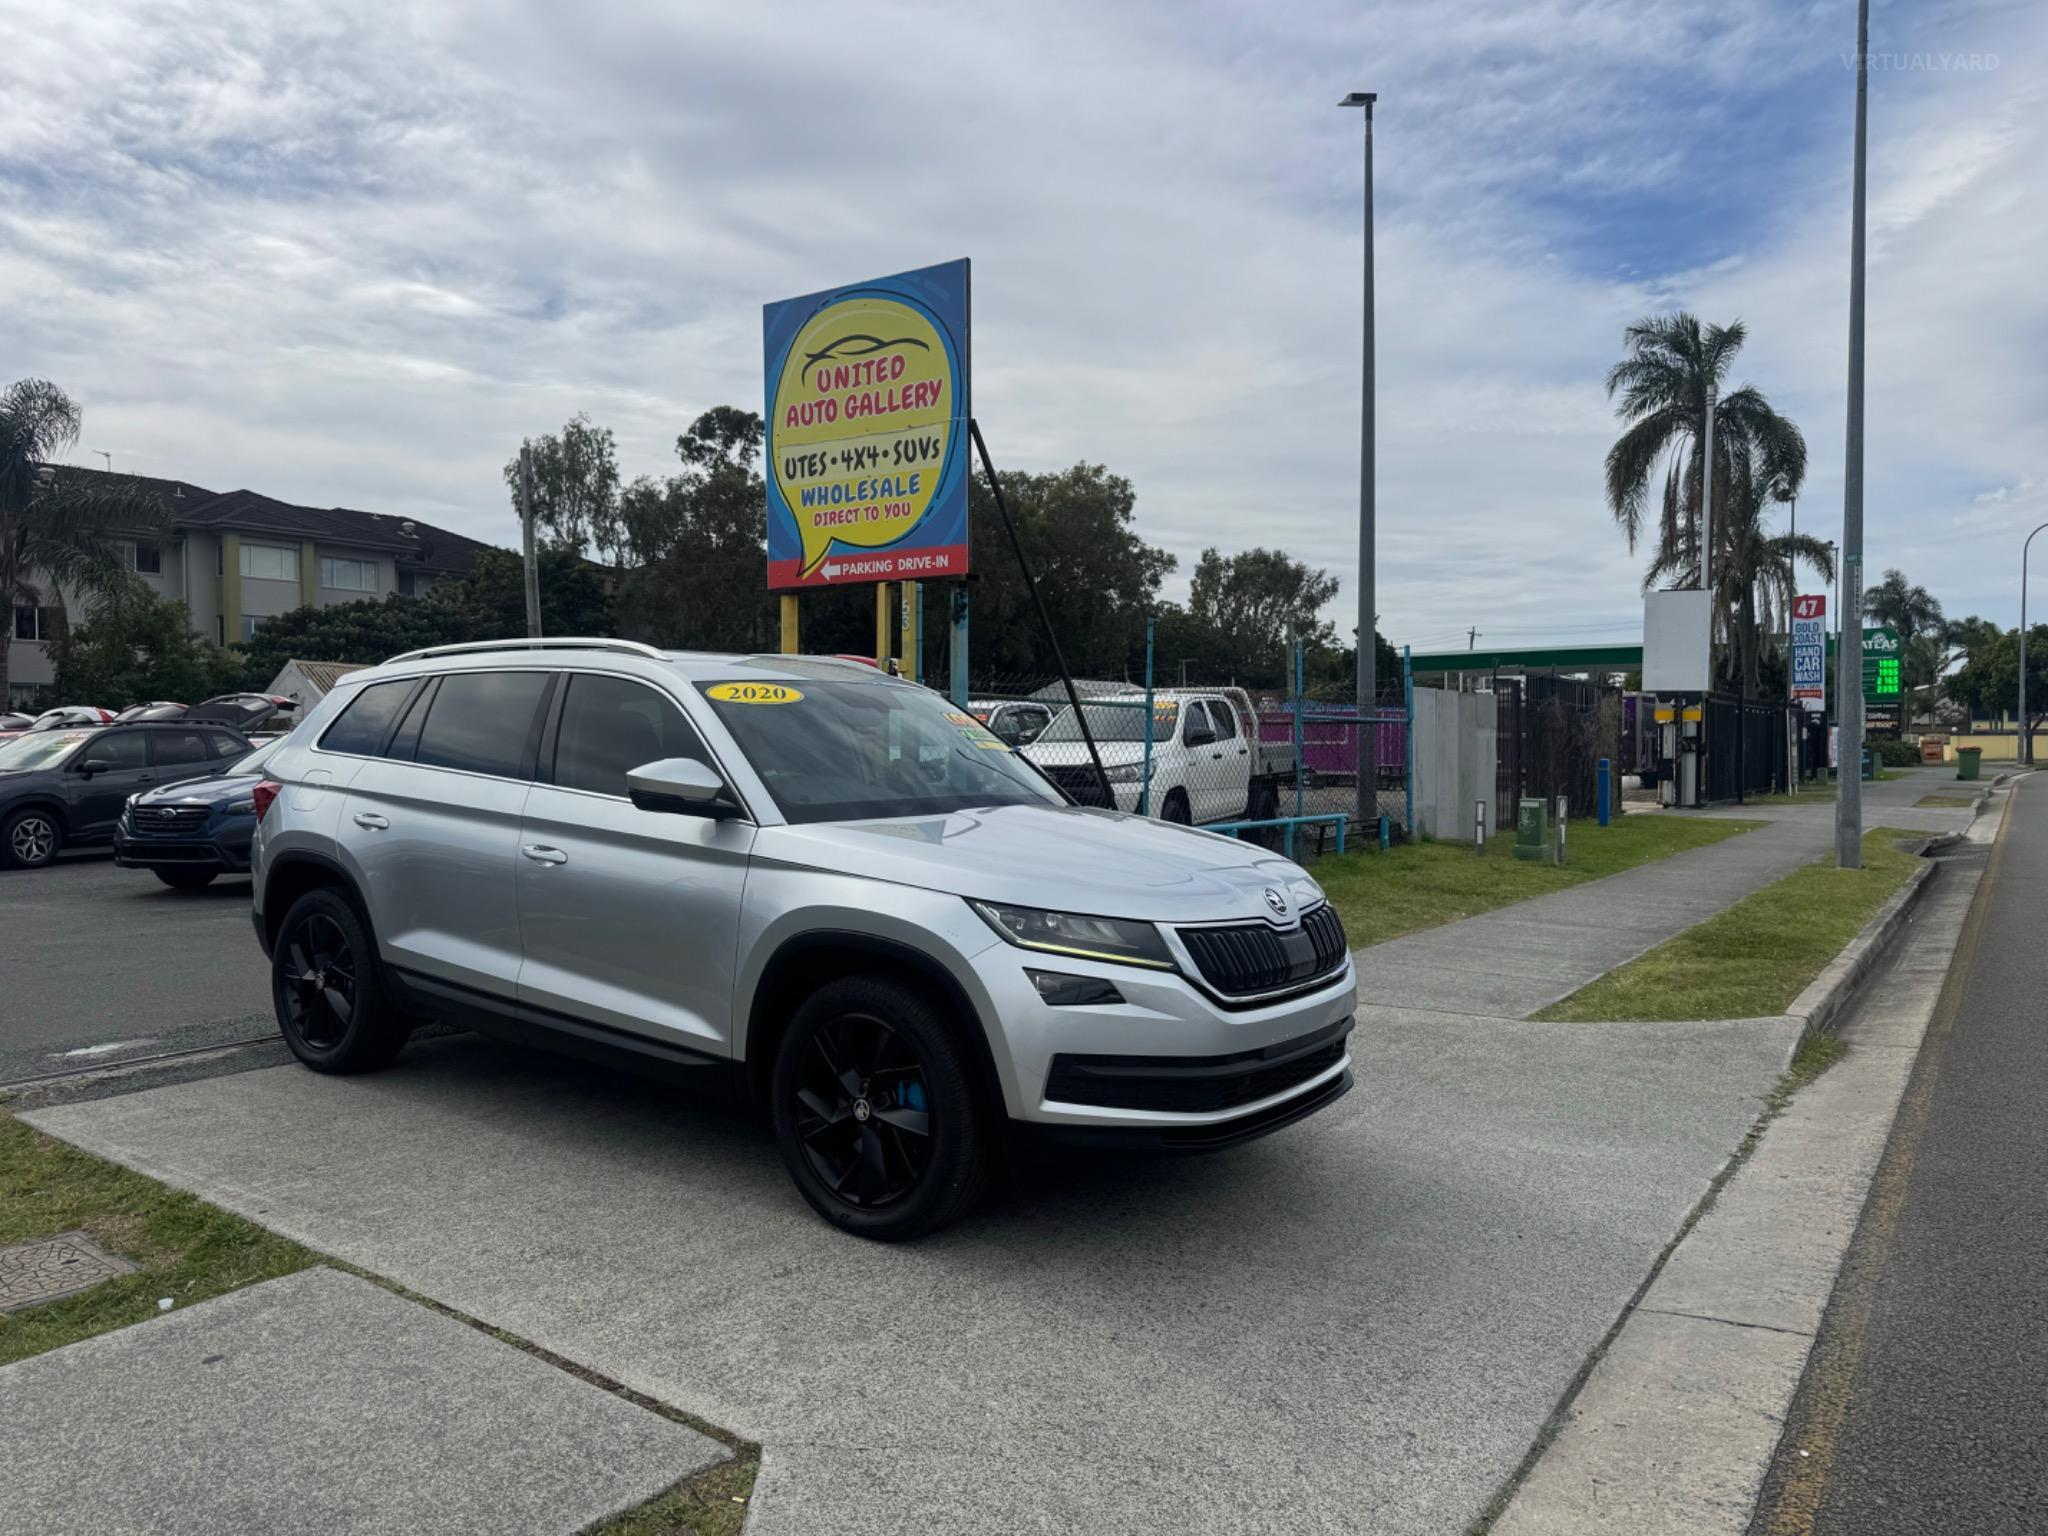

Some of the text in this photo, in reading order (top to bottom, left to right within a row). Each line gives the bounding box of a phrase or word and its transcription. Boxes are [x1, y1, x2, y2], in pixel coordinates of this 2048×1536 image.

[816, 354, 906, 393] UNITED
[786, 378, 943, 428] AUTO GALLERY
[785, 451, 827, 480] UTES
[801, 473, 920, 507] WHOLESALE
[814, 502, 911, 527] DIRECT TO YOU
[842, 555, 948, 575] PARKING DRIVE-IN
[1797, 600, 1818, 616] 47
[1796, 622, 1819, 633] GOLD
[1793, 633, 1821, 643] COAST
[1795, 646, 1820, 657] HAND
[1794, 657, 1820, 671] CAR
[1795, 670, 1821, 682] WASH
[728, 686, 787, 700] 2020
